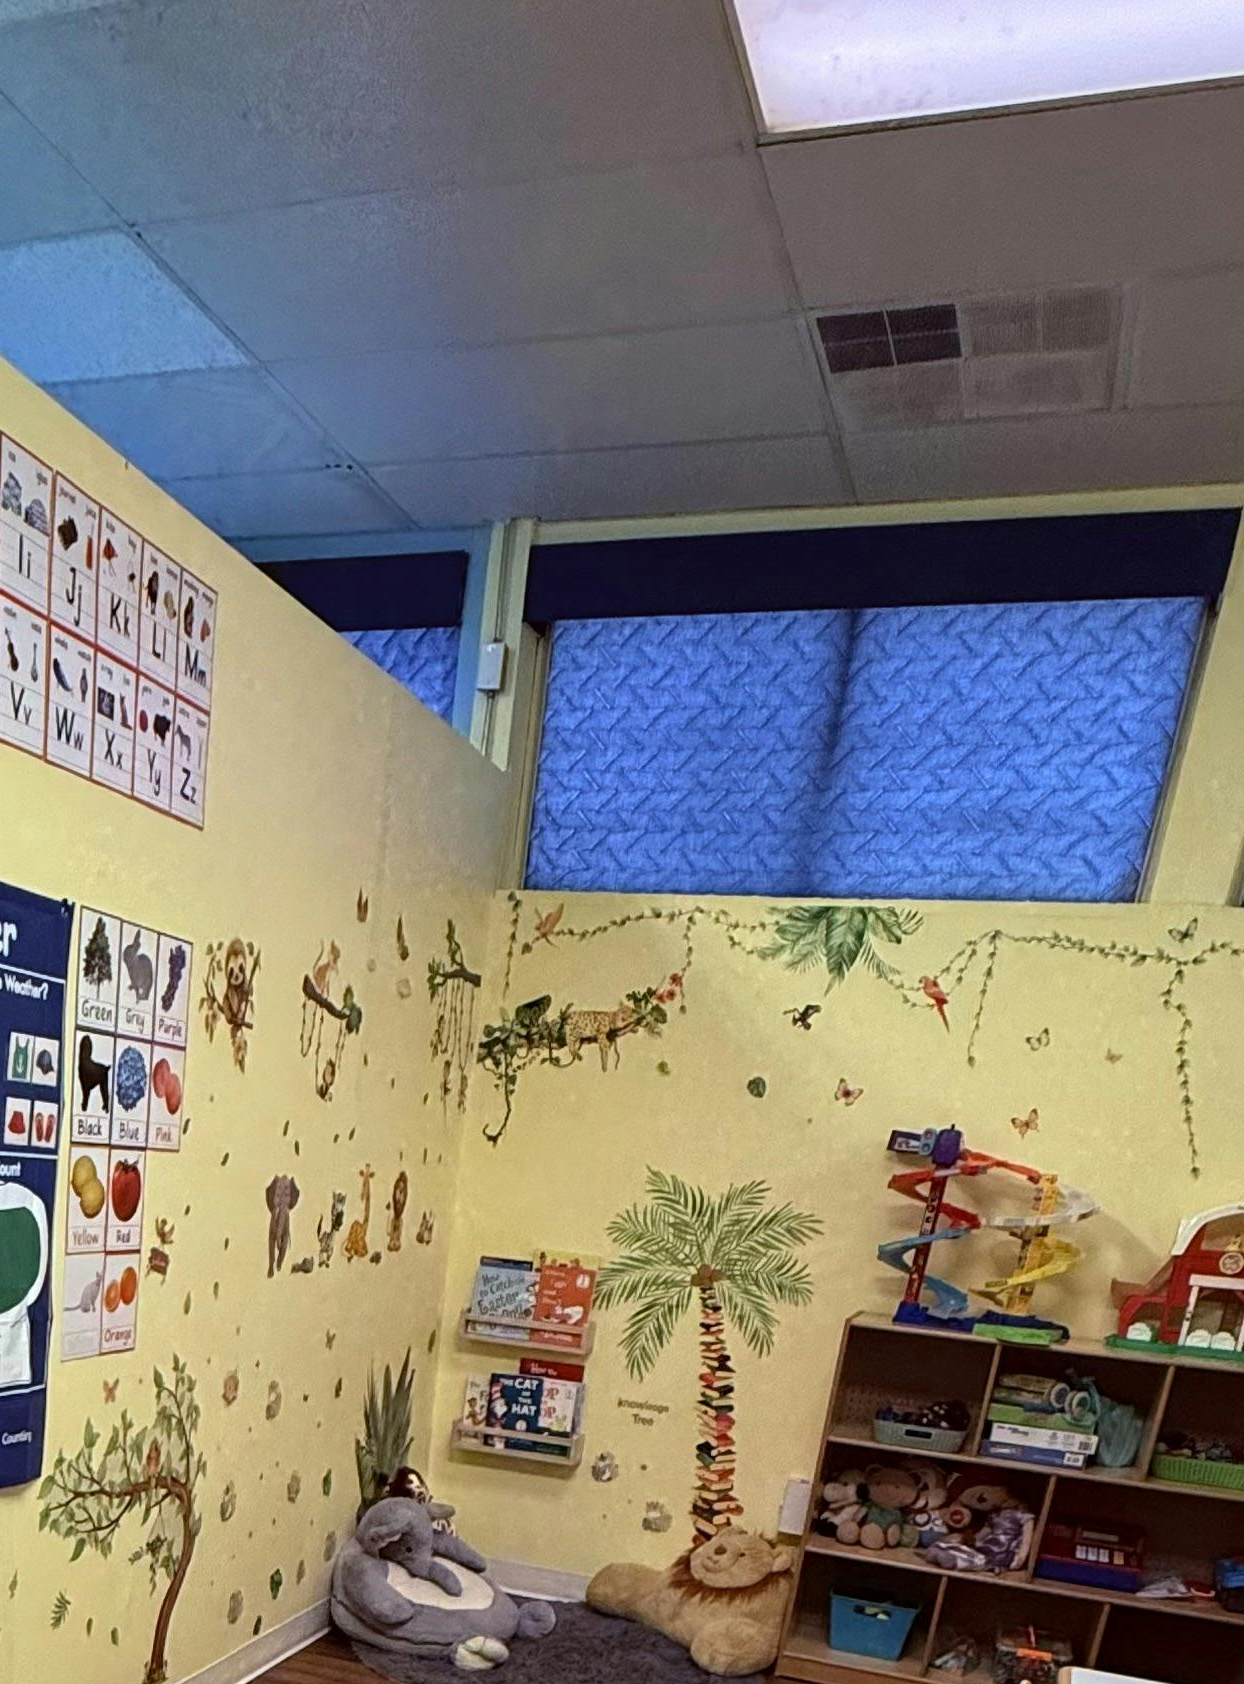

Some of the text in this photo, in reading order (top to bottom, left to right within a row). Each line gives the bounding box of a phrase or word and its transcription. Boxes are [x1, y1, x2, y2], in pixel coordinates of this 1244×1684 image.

[65, 567, 84, 627] Jj
[110, 593, 131, 638] Kk
[185, 643, 206, 685] Mm
[10, 682, 32, 726] Vv
[56, 711, 84, 751] Ww
[104, 734, 123, 770] Xx
[147, 748, 161, 796] Yy
[180, 768, 196, 804] Zz
[4, 973, 49, 1000] Weather?
[81, 999, 113, 1022] Green
[159, 1018, 182, 1040] Purple
[77, 1116, 103, 1137] Black
[119, 1122, 140, 1141] Blue
[155, 1127, 172, 1143] Pink
[73, 1229, 100, 1246] Yellow
[116, 1229, 131, 1244] Red
[105, 1328, 132, 1346] Orange
[514, 1378, 539, 1390] CAT
[511, 1403, 537, 1416] HAT
